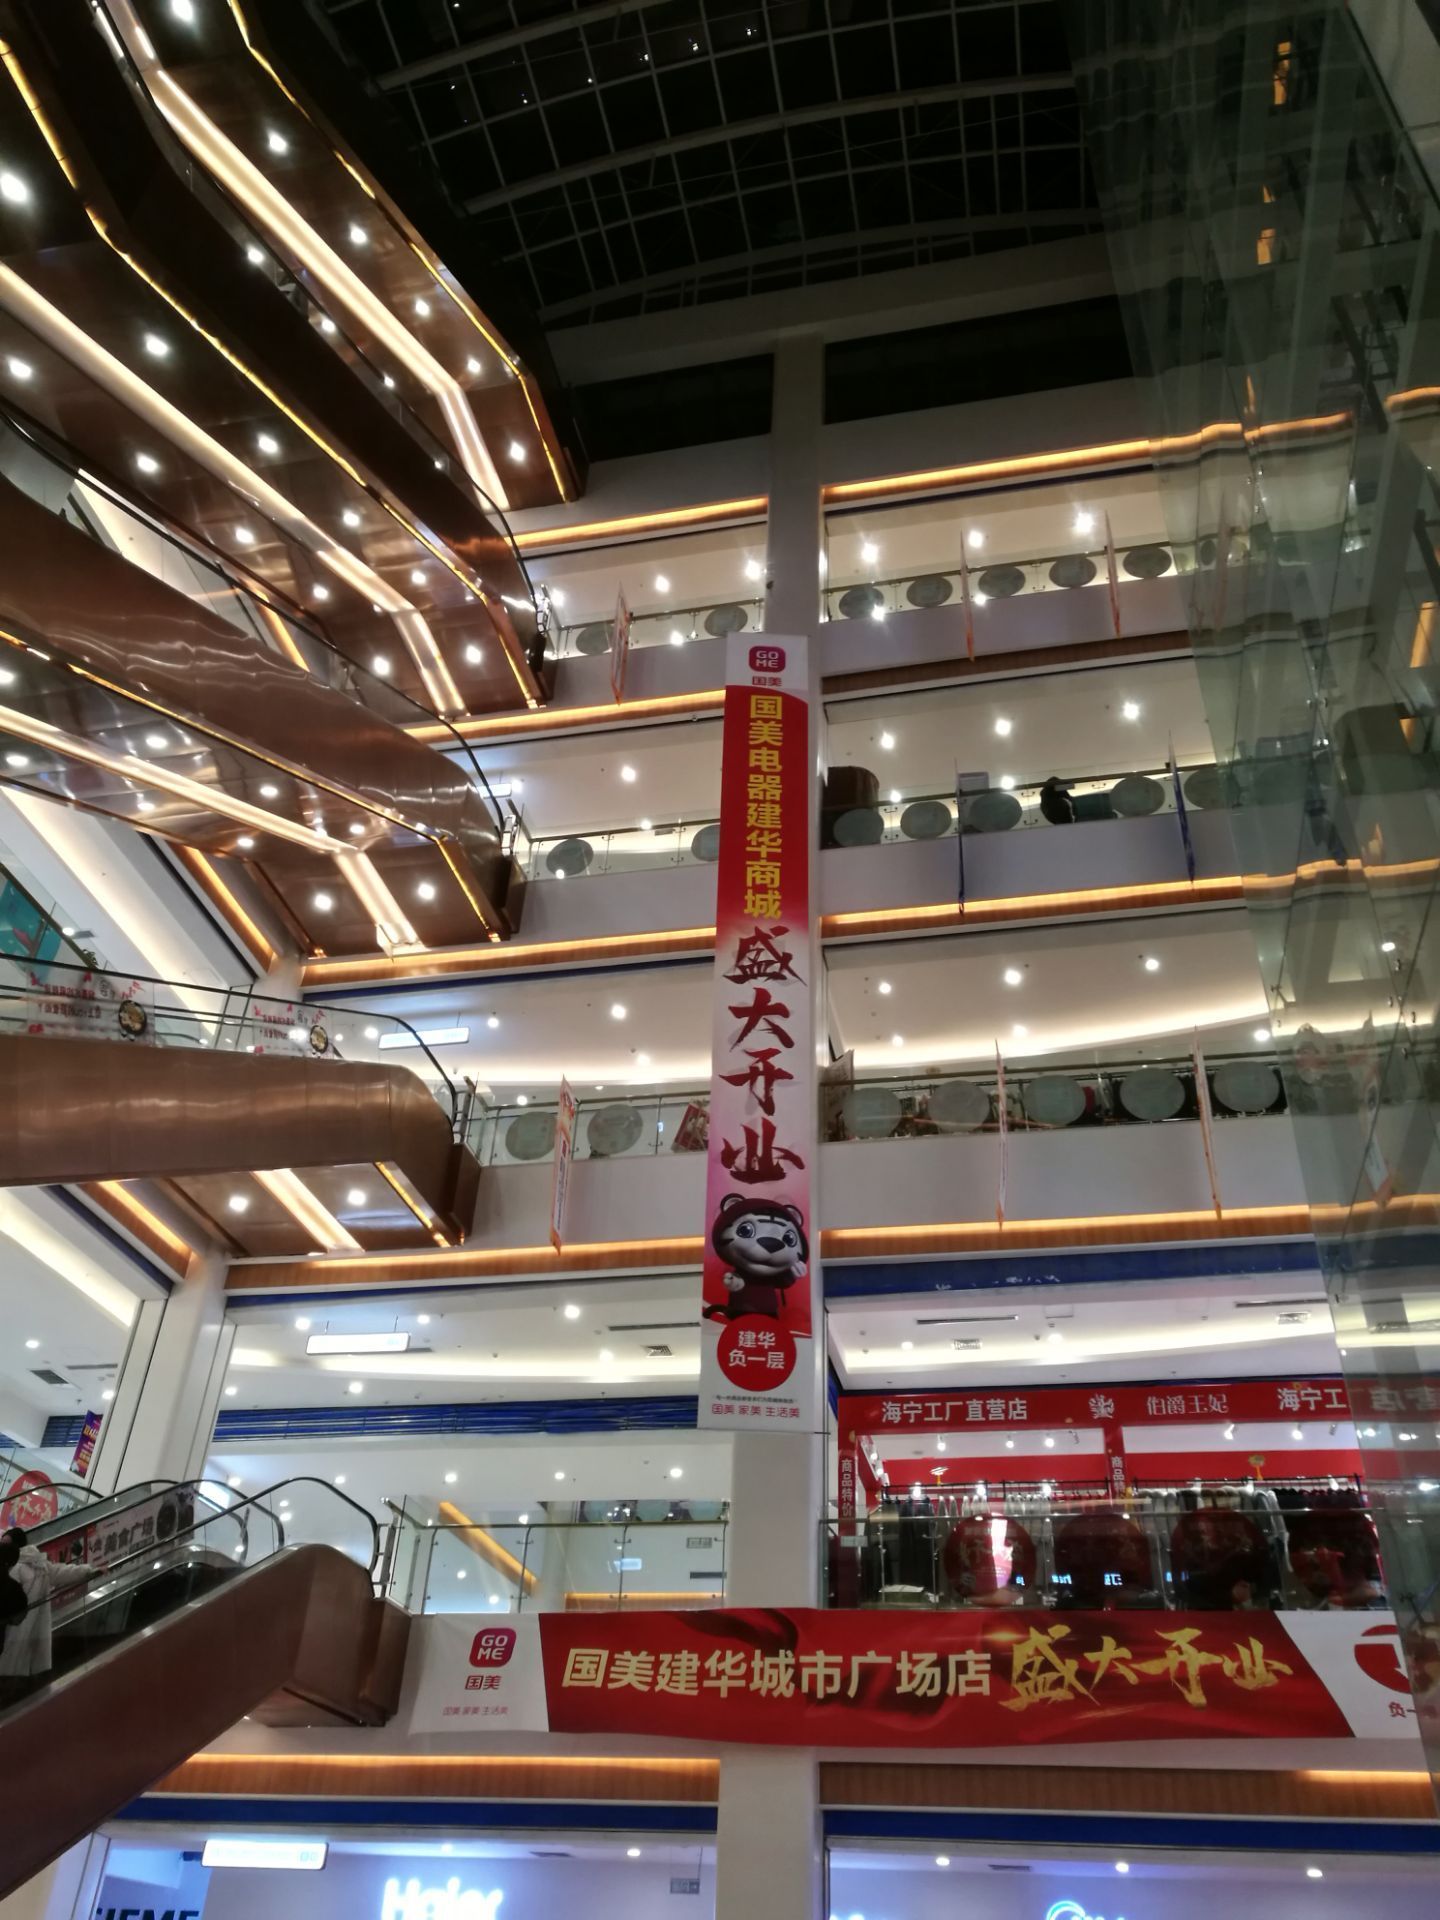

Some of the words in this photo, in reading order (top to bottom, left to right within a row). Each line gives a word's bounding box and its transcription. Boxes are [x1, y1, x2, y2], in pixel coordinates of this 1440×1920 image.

[752, 676, 782, 687] 国美
[744, 694, 784, 920] 国美电器建华商城
[718, 925, 808, 1185] 盛大开业
[738, 1330, 776, 1349] 建华
[728, 1349, 785, 1369] 负一层
[711, 1403, 735, 1415] 国美
[881, 1398, 1027, 1424] 海宁工厂直营店
[1146, 1393, 1229, 1416] 伯爵王妃
[841, 1458, 853, 1517] 商品特价
[481, 1634, 509, 1648] GO
[476, 1647, 505, 1661] ME
[561, 1647, 992, 1698] 国美建华城市广场店
[999, 1623, 1293, 1711] 盛大开业
[464, 1674, 502, 1691] 国美
